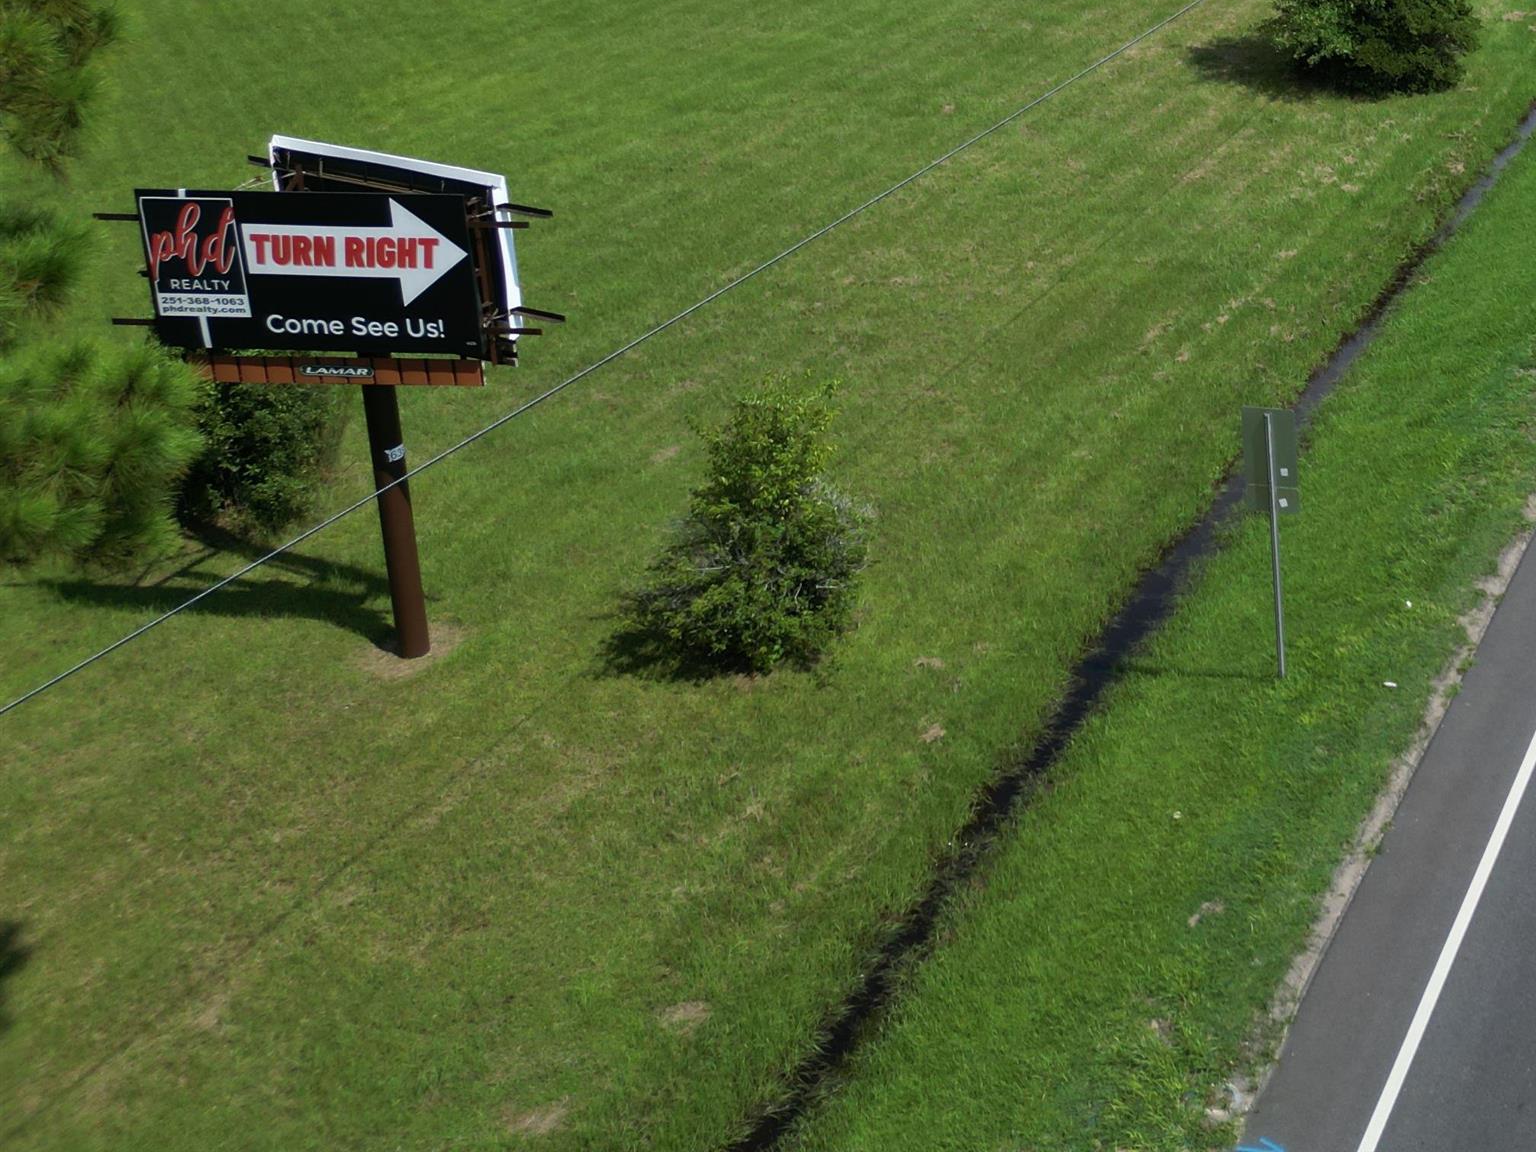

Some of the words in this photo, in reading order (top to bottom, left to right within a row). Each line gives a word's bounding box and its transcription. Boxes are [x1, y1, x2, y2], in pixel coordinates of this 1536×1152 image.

[149, 202, 237, 282] phd
[249, 233, 336, 267] TURN
[345, 236, 440, 270] RIGHT
[170, 277, 231, 291] REALTY
[161, 296, 245, 307] 251-368-1063
[162, 305, 247, 316] phdrealty.com
[266, 313, 345, 336] Come
[351, 316, 399, 338] See
[406, 317, 446, 339] Us!
[305, 366, 369, 377] LAMAR
